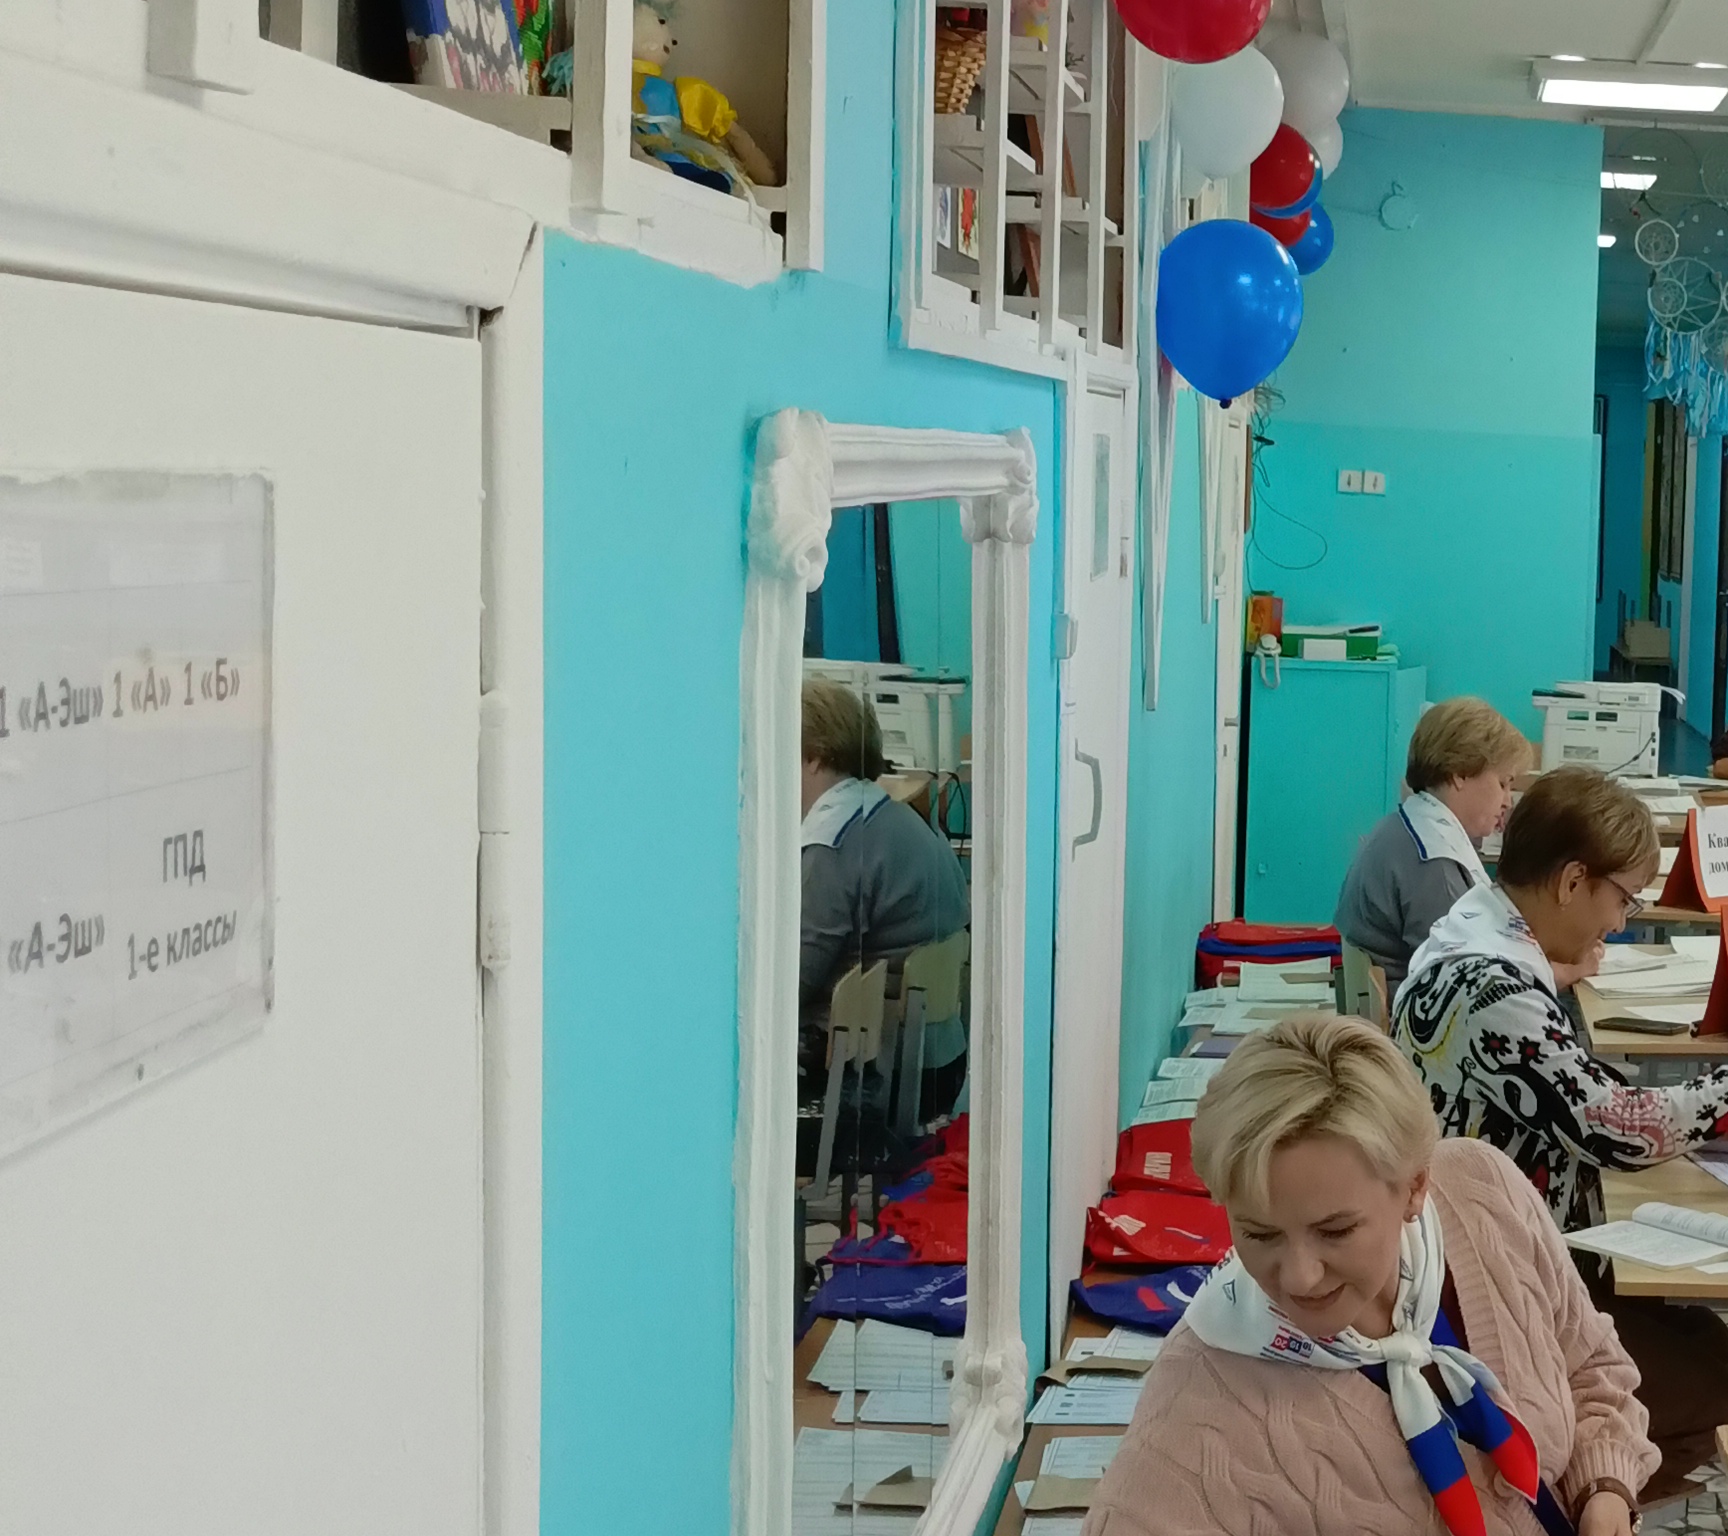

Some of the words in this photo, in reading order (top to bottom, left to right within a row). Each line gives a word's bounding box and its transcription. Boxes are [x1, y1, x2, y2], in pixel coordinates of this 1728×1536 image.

[0, 685, 10, 738] 1
[112, 670, 124, 718] 1
[130, 666, 172, 713] «А»
[183, 661, 194, 706] 1
[200, 657, 240, 702] «Б»
[162, 828, 207, 887] ГПД
[126, 932, 160, 981] 1-е
[166, 909, 237, 967] классы
